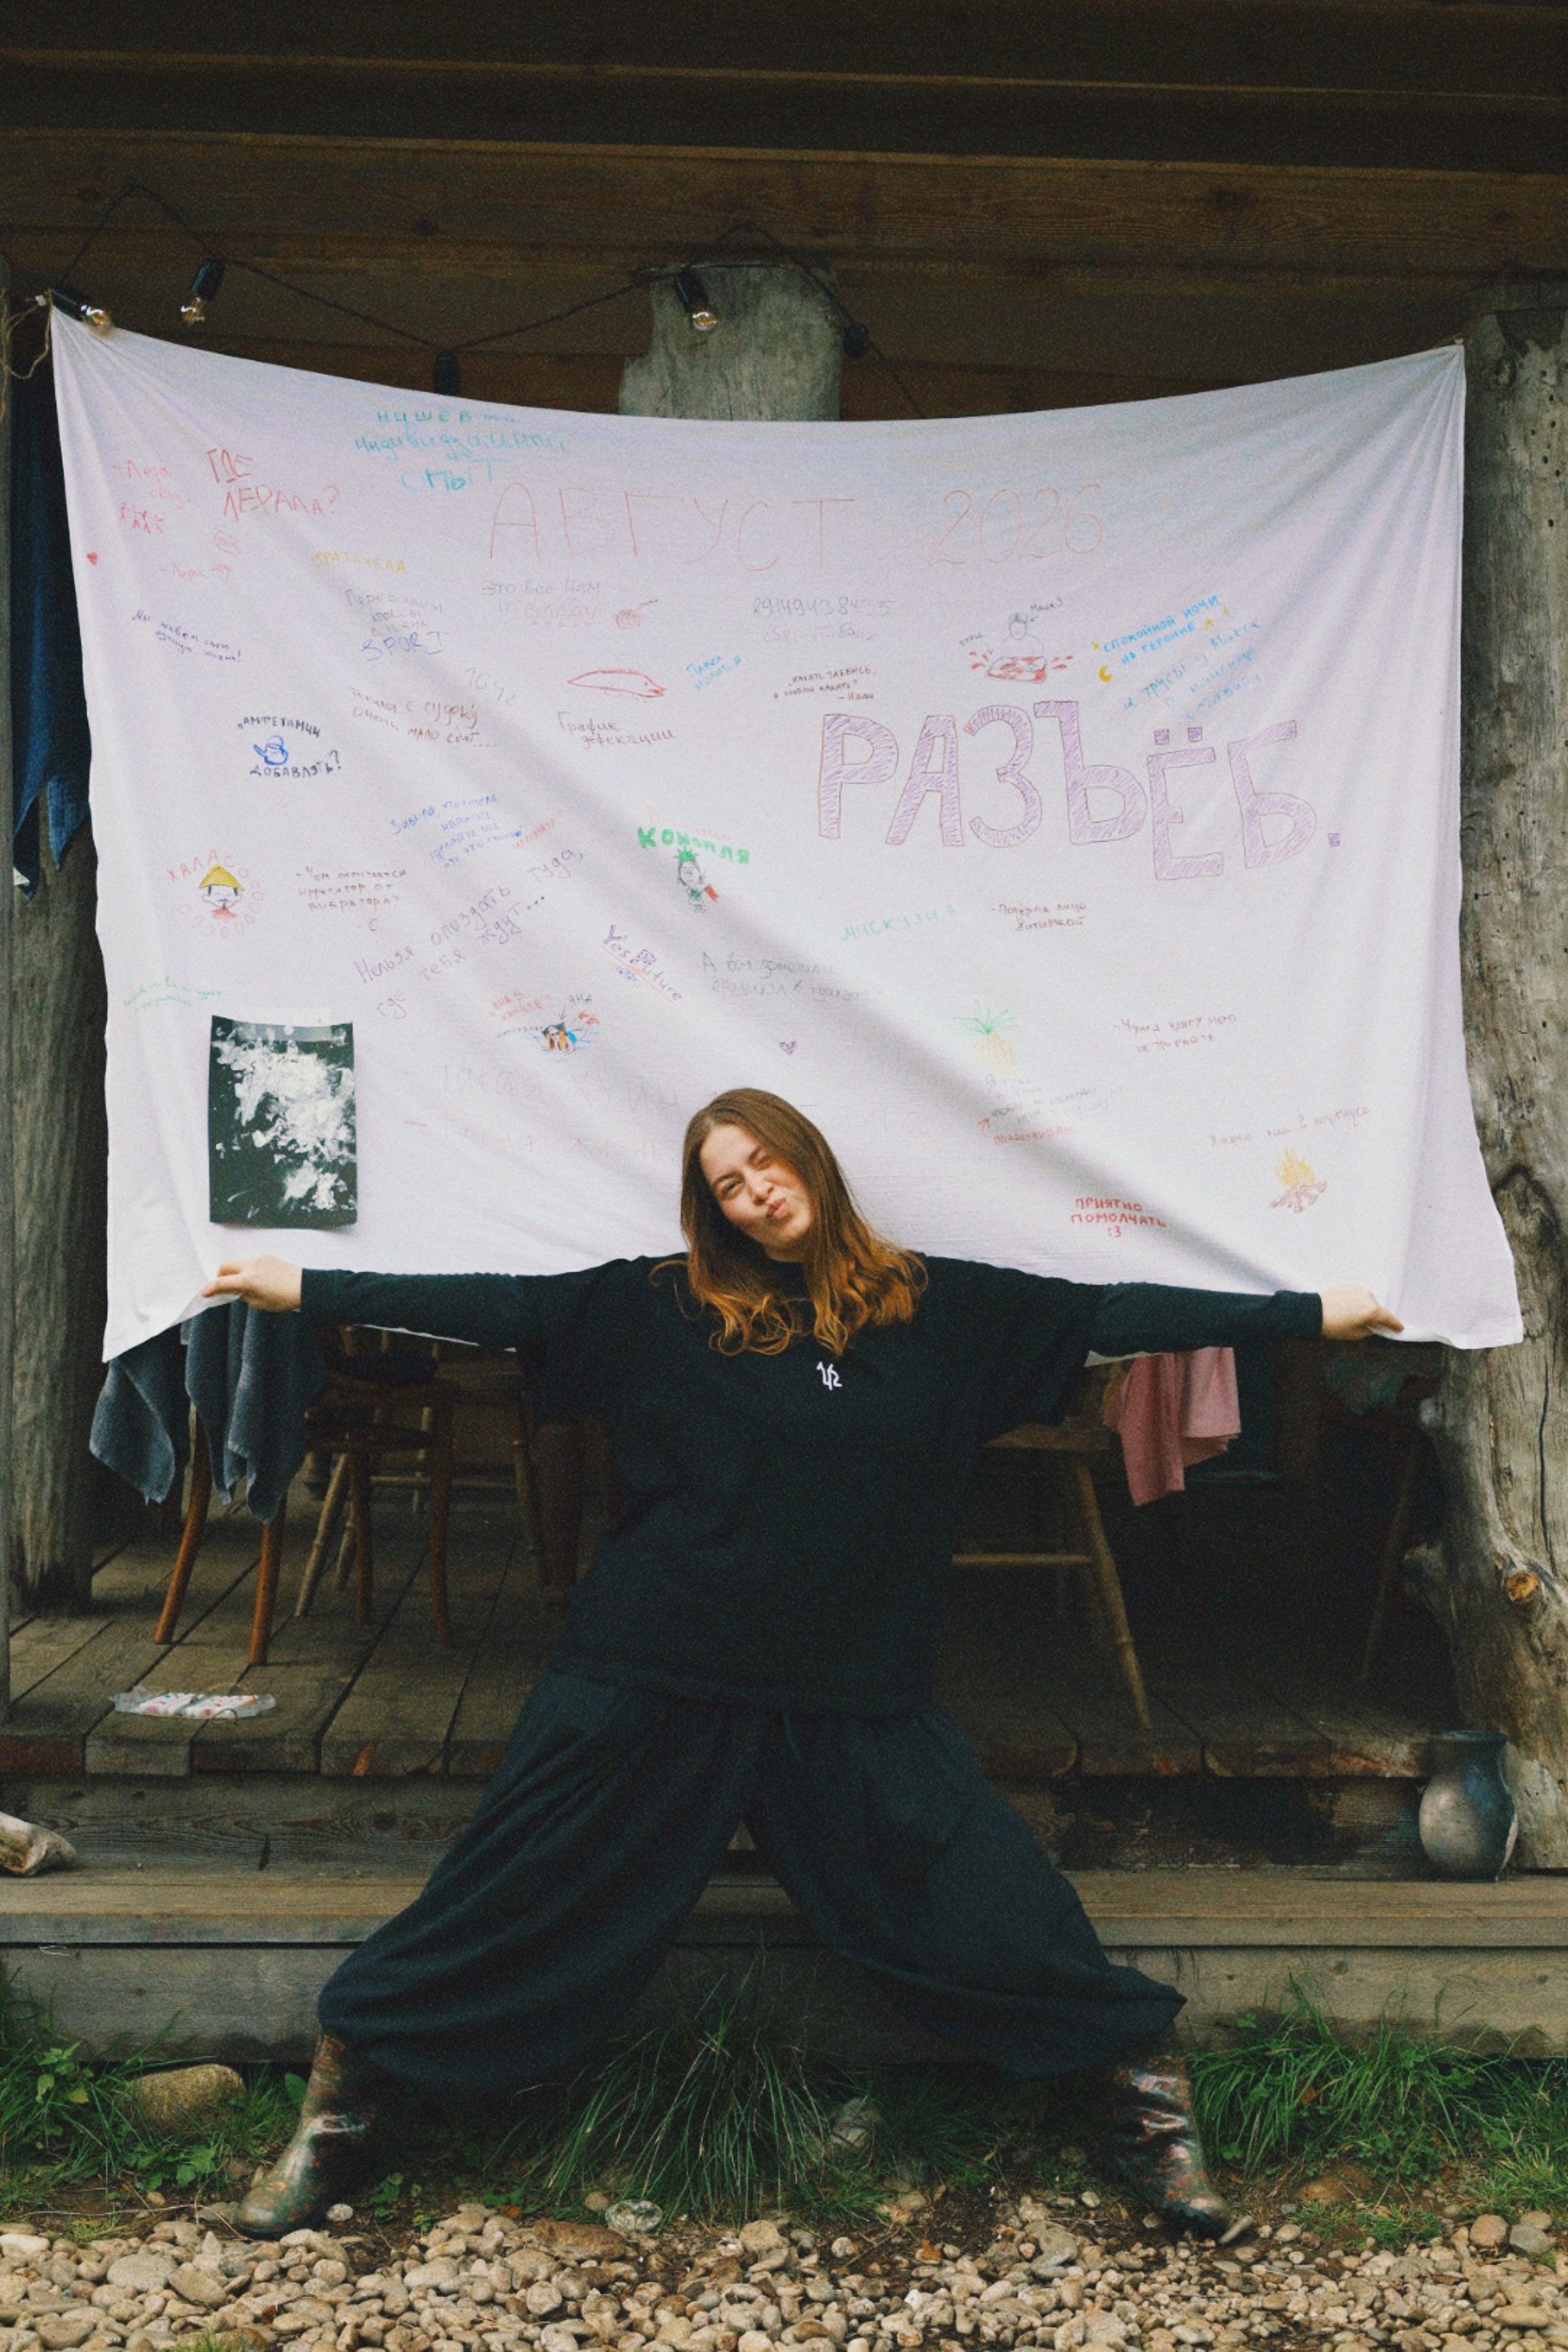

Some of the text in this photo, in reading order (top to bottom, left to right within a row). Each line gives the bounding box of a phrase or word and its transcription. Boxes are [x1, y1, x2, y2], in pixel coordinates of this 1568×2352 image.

[206, 447, 254, 483] ГДЕ
[489, 481, 1104, 571] АВГУСТ 2026
[1074, 1197, 1143, 1212] ПРИЯТНО
[1070, 1213, 1167, 1228] ПОМОЛЧАТЬ
